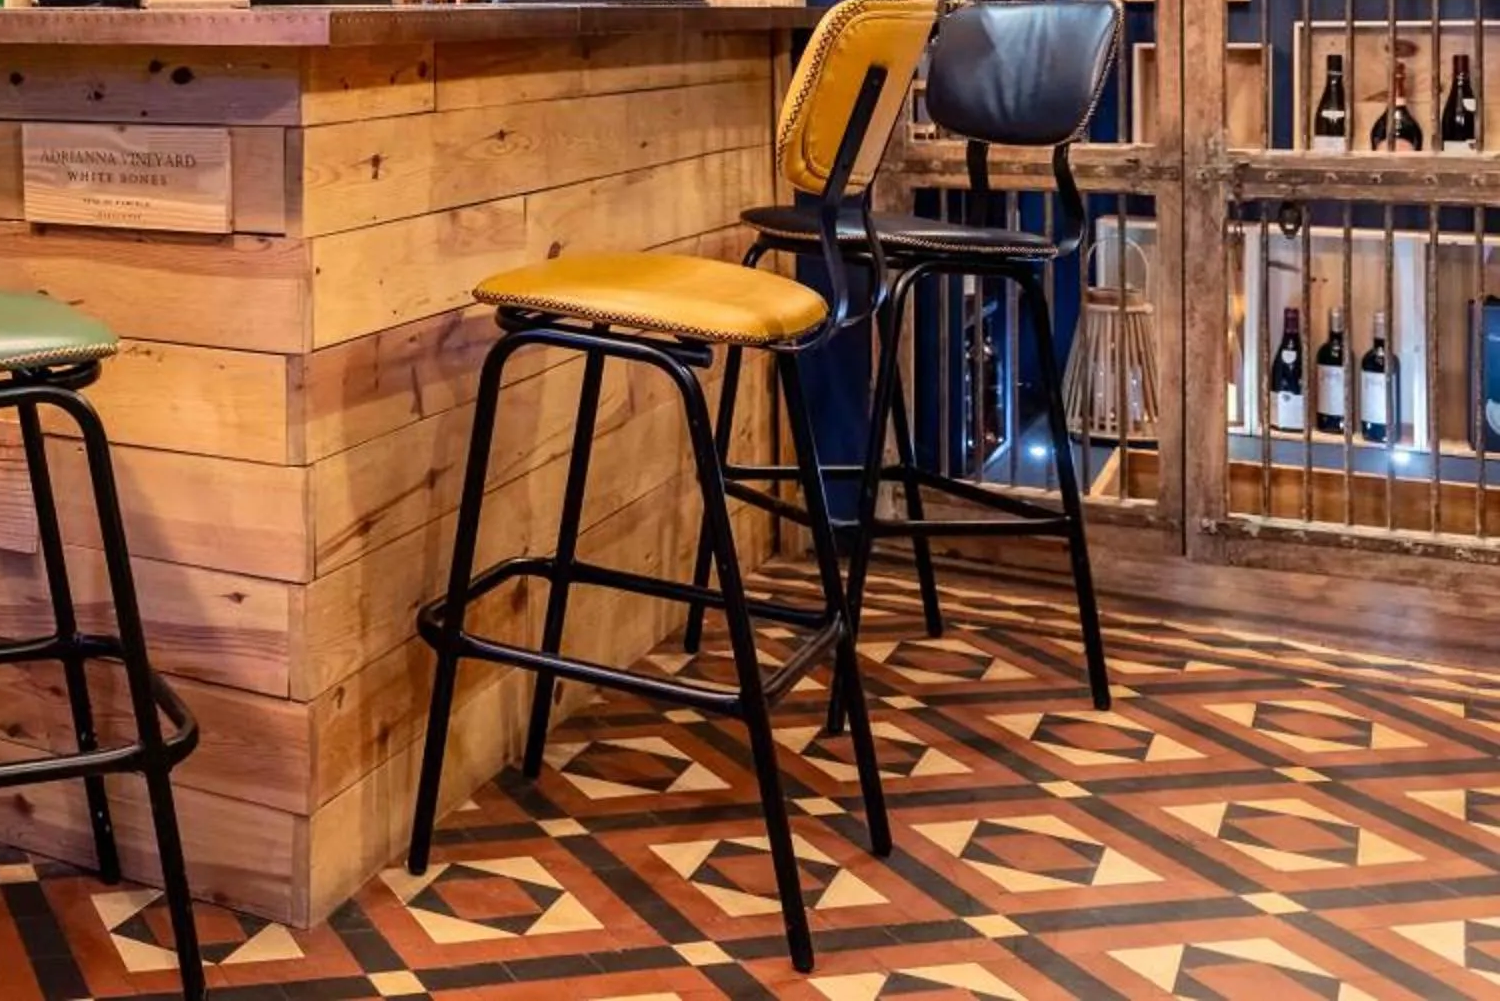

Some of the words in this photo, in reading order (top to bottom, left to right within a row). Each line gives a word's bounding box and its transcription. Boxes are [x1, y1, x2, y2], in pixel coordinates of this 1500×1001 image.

[40, 150, 116, 167] ADRIANNA
[122, 151, 197, 169] VINEYARD
[67, 170, 114, 185] WHITE
[120, 173, 169, 187] BONES
